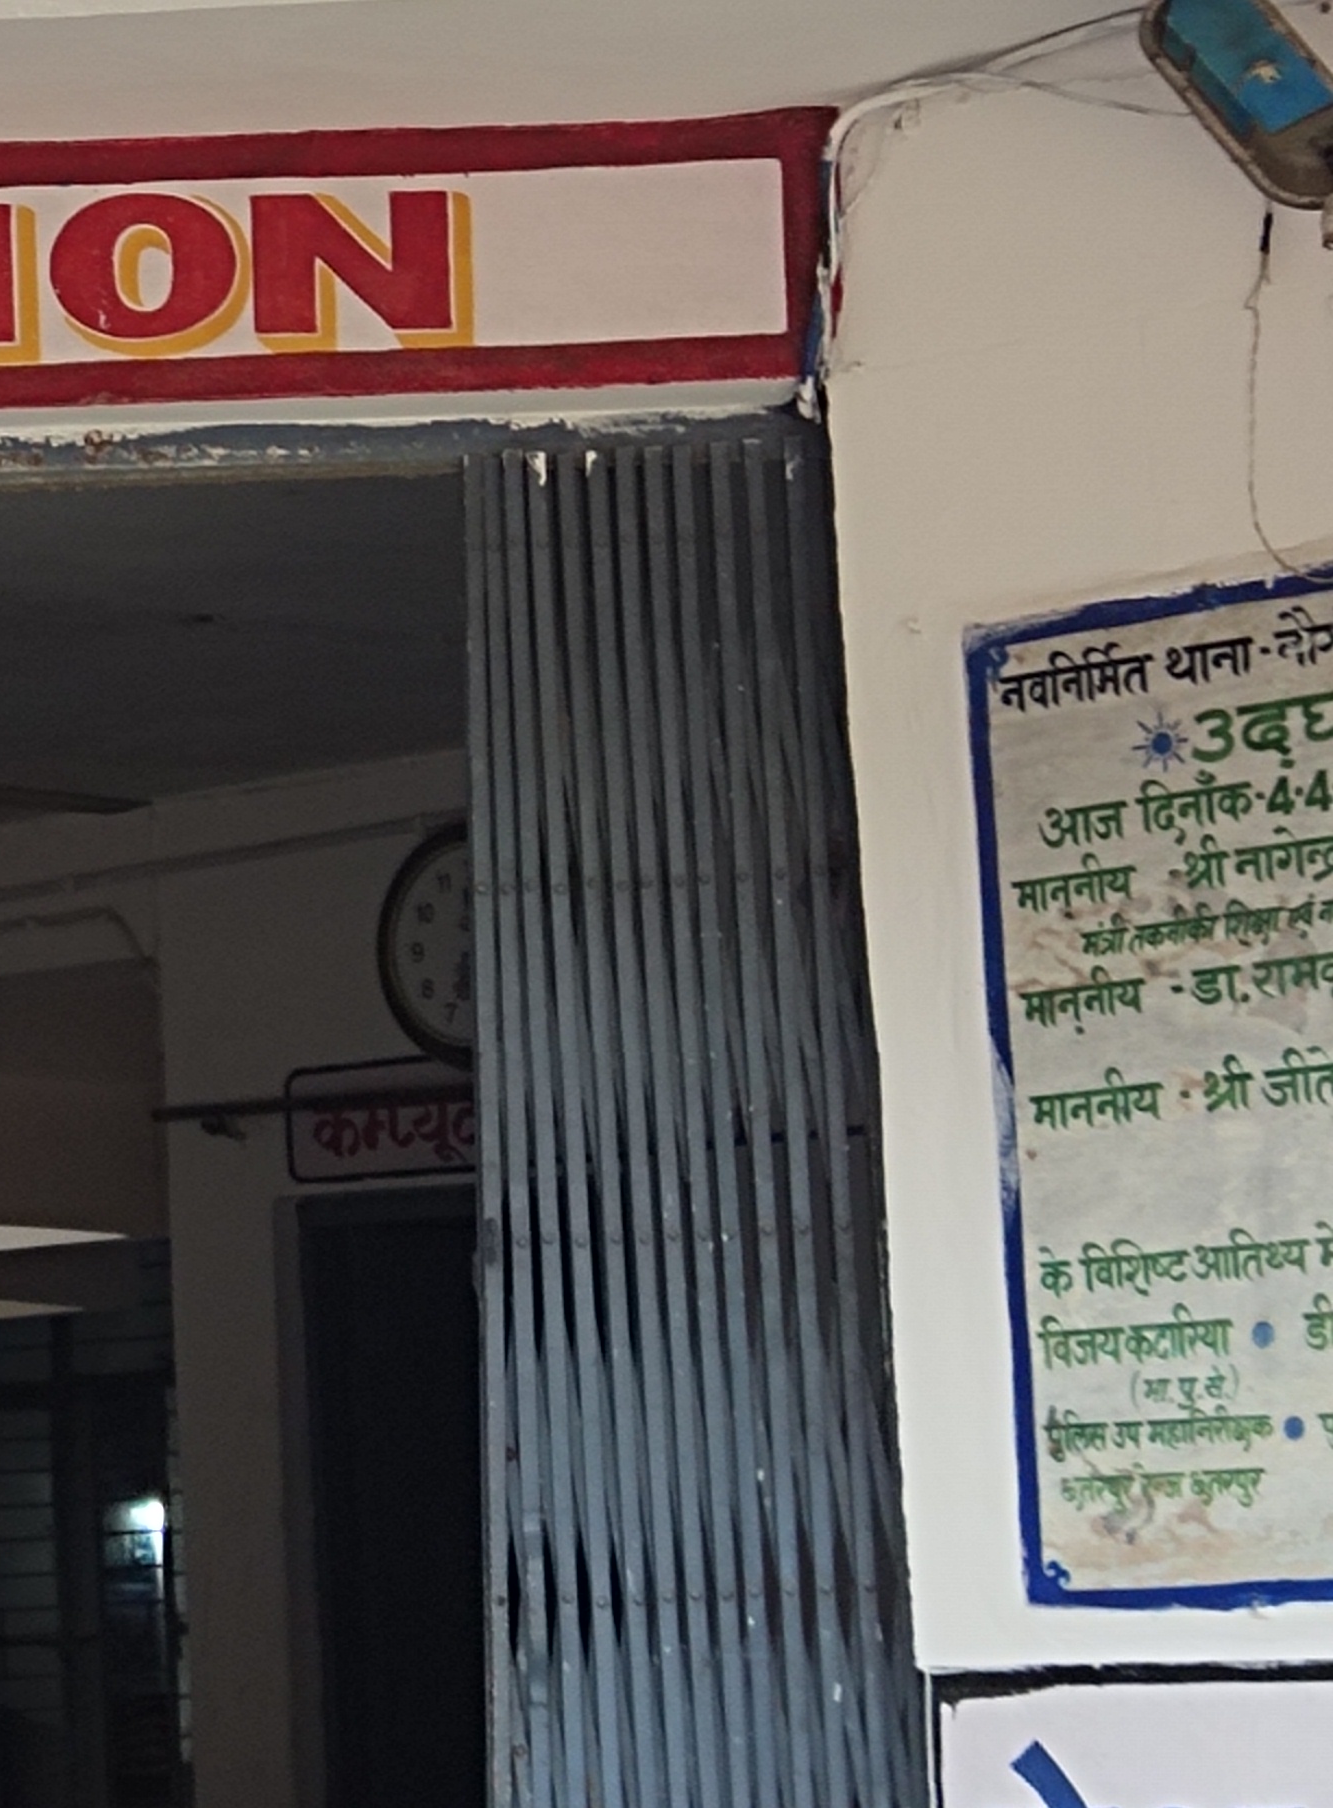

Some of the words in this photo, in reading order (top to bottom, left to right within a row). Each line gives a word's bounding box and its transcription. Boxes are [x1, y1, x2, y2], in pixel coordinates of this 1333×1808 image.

[999, 641, 1154, 712] नवनिर्मित
[1165, 637, 1254, 685] थाना
[1038, 800, 1128, 848] आज
[1183, 834, 1230, 890] श्री
[1028, 1066, 1165, 1130] माननीय
[1202, 1053, 1255, 1112] श्री
[1038, 1245, 1074, 1299] के
[1078, 1238, 1191, 1297] विशिष्ट
[1036, 1315, 1125, 1370] विजय
[1125, 1302, 1234, 1364] कटारिया
